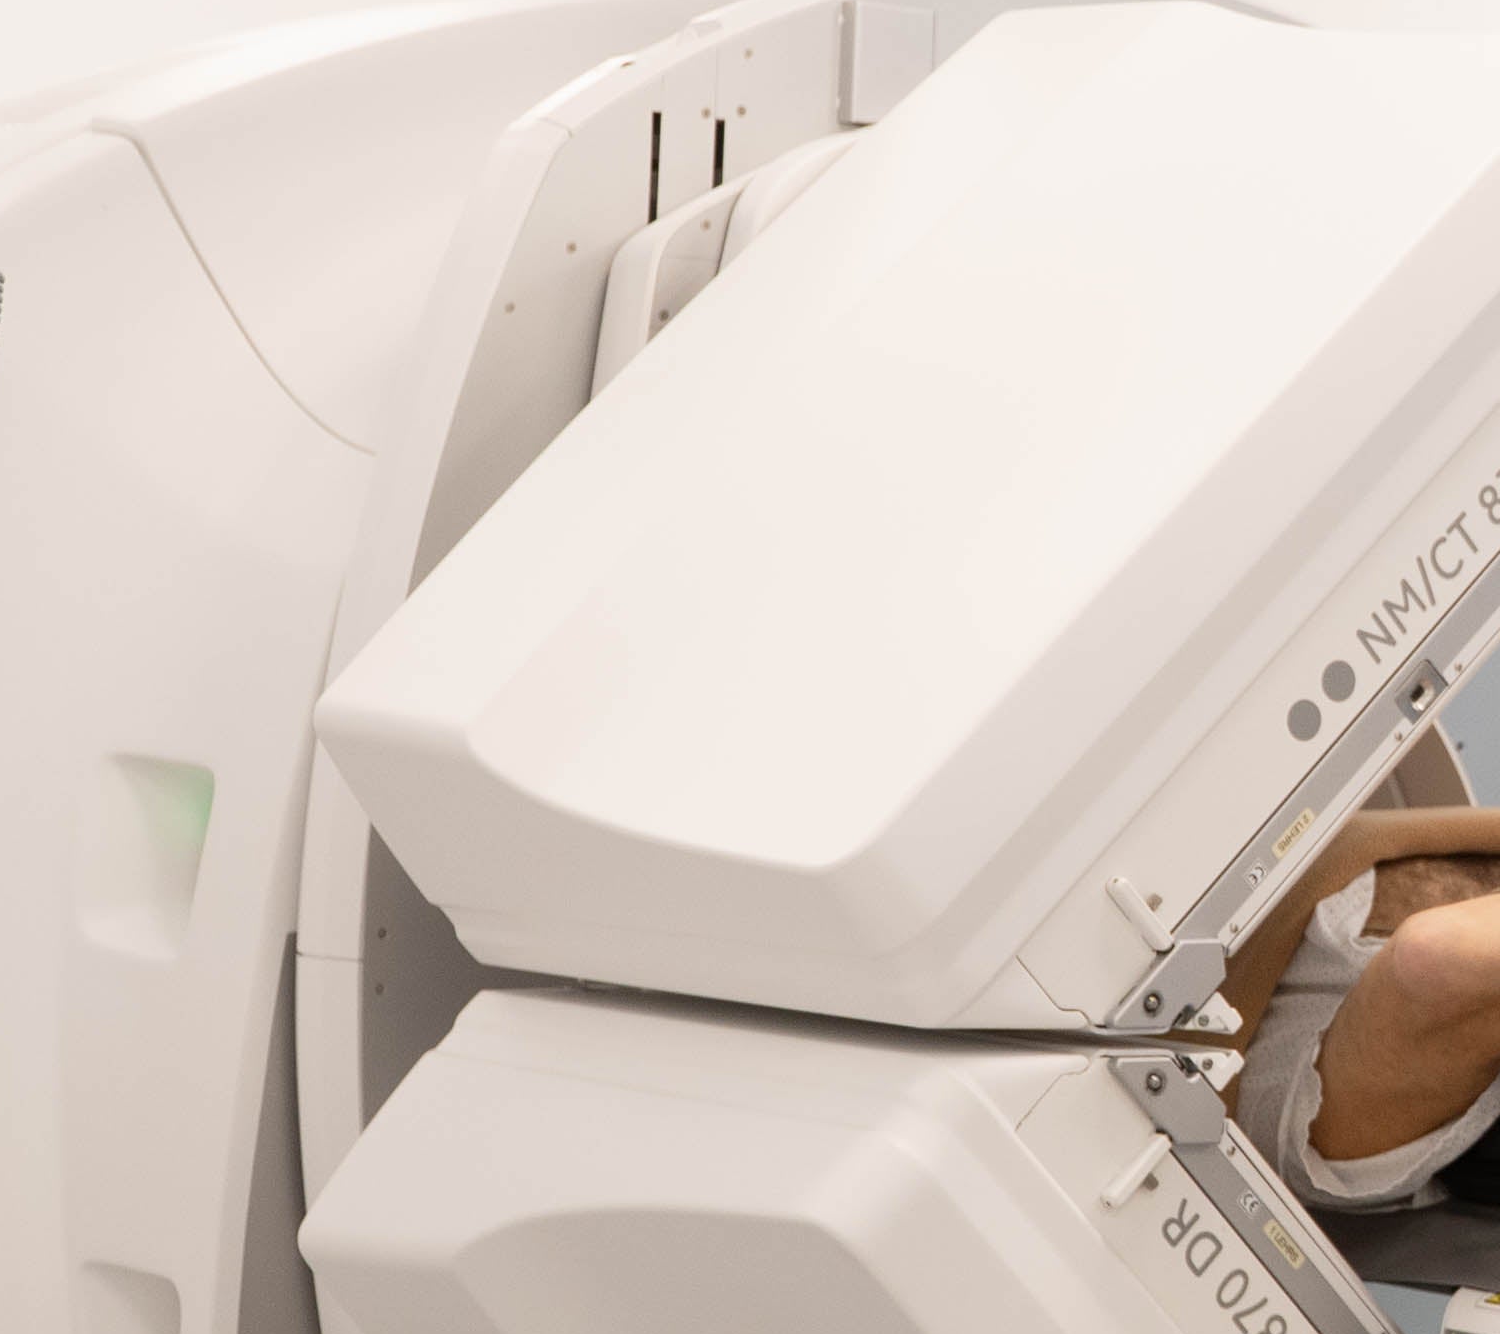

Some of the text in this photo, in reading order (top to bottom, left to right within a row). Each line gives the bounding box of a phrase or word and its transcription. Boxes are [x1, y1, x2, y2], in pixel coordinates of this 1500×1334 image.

[1357, 511, 1479, 665] NM/CT
[1161, 1196, 1223, 1276] DR
[1243, 1193, 1259, 1213] CE
